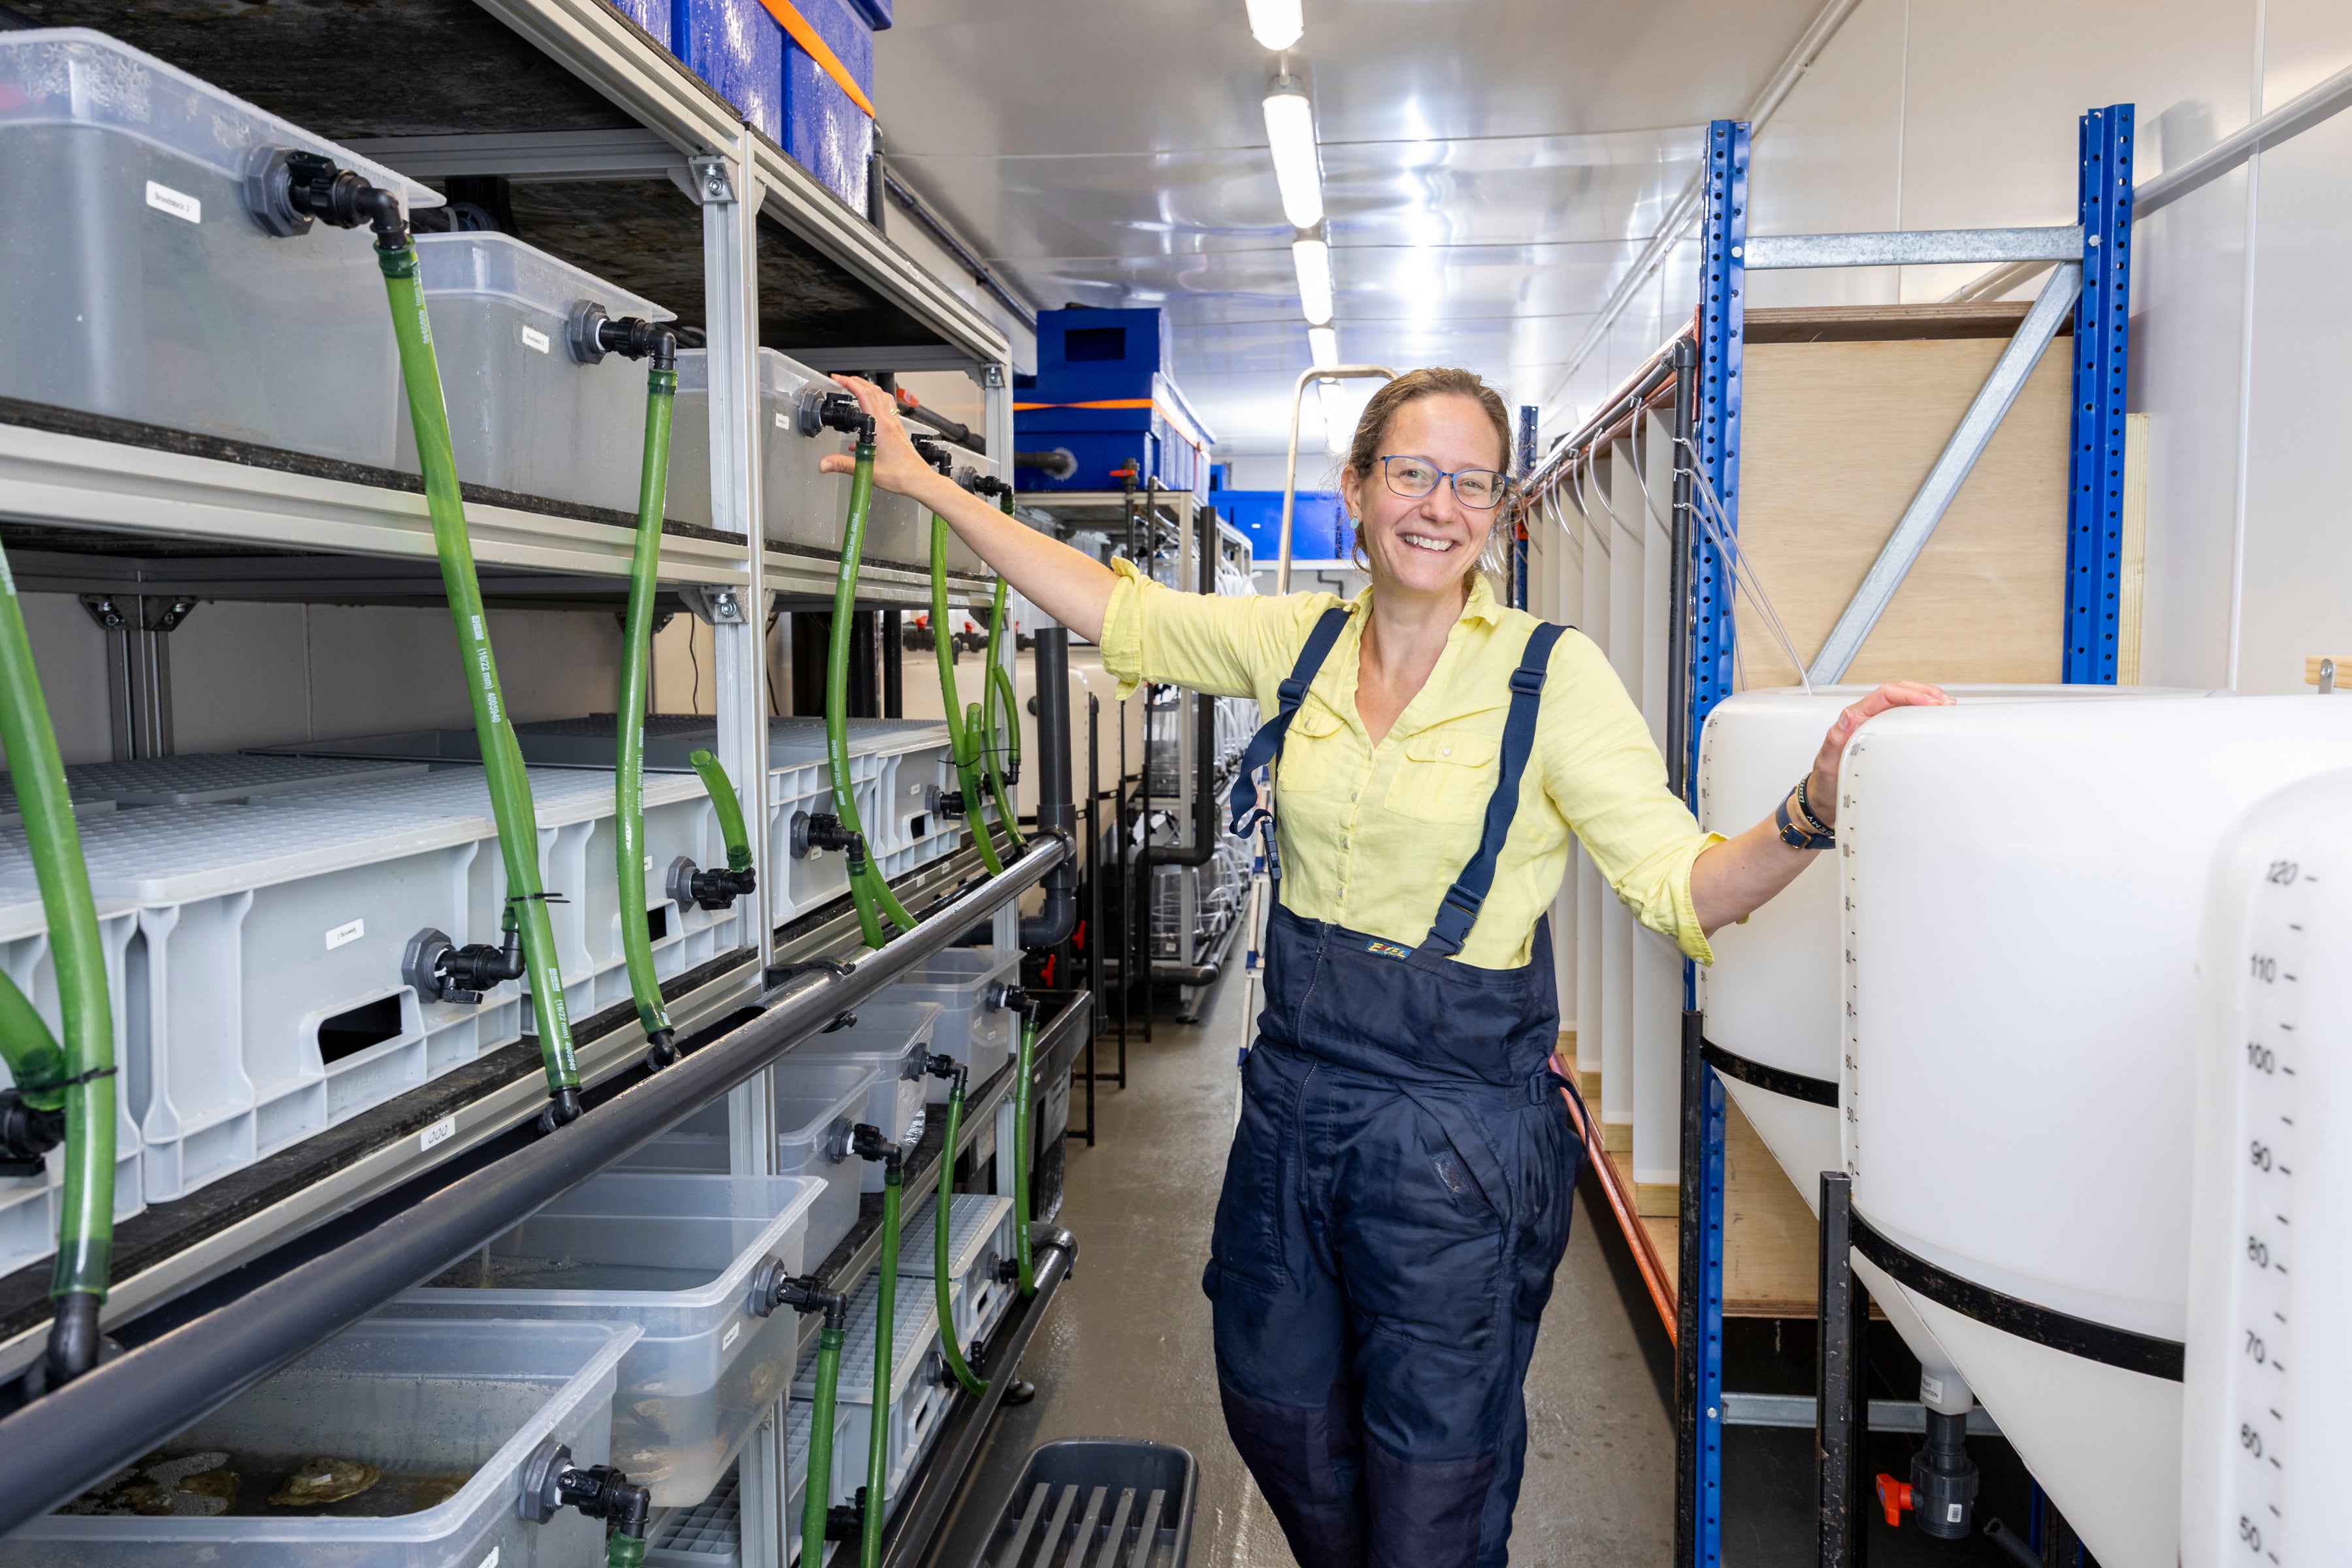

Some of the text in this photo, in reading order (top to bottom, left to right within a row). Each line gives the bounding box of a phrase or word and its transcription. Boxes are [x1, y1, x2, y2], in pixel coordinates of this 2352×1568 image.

[471, 615, 501, 724] EHEIM (16/22 mm) 4005940
[2265, 860, 2299, 885] 120
[2250, 953, 2276, 984] 110
[554, 1000, 566, 1021] (16/22
[561, 1022, 570, 1039] mm)
[565, 1041, 577, 1071] 4005940
[2247, 1041, 2275, 1075] 100
[1847, 1105, 1854, 1123] 50
[2249, 1140, 2272, 1173] 90
[2247, 1235, 2269, 1268] 80
[2245, 1329, 2266, 1365] 70
[2240, 1423, 2262, 1459] 60
[2239, 1515, 2262, 1552] 50
